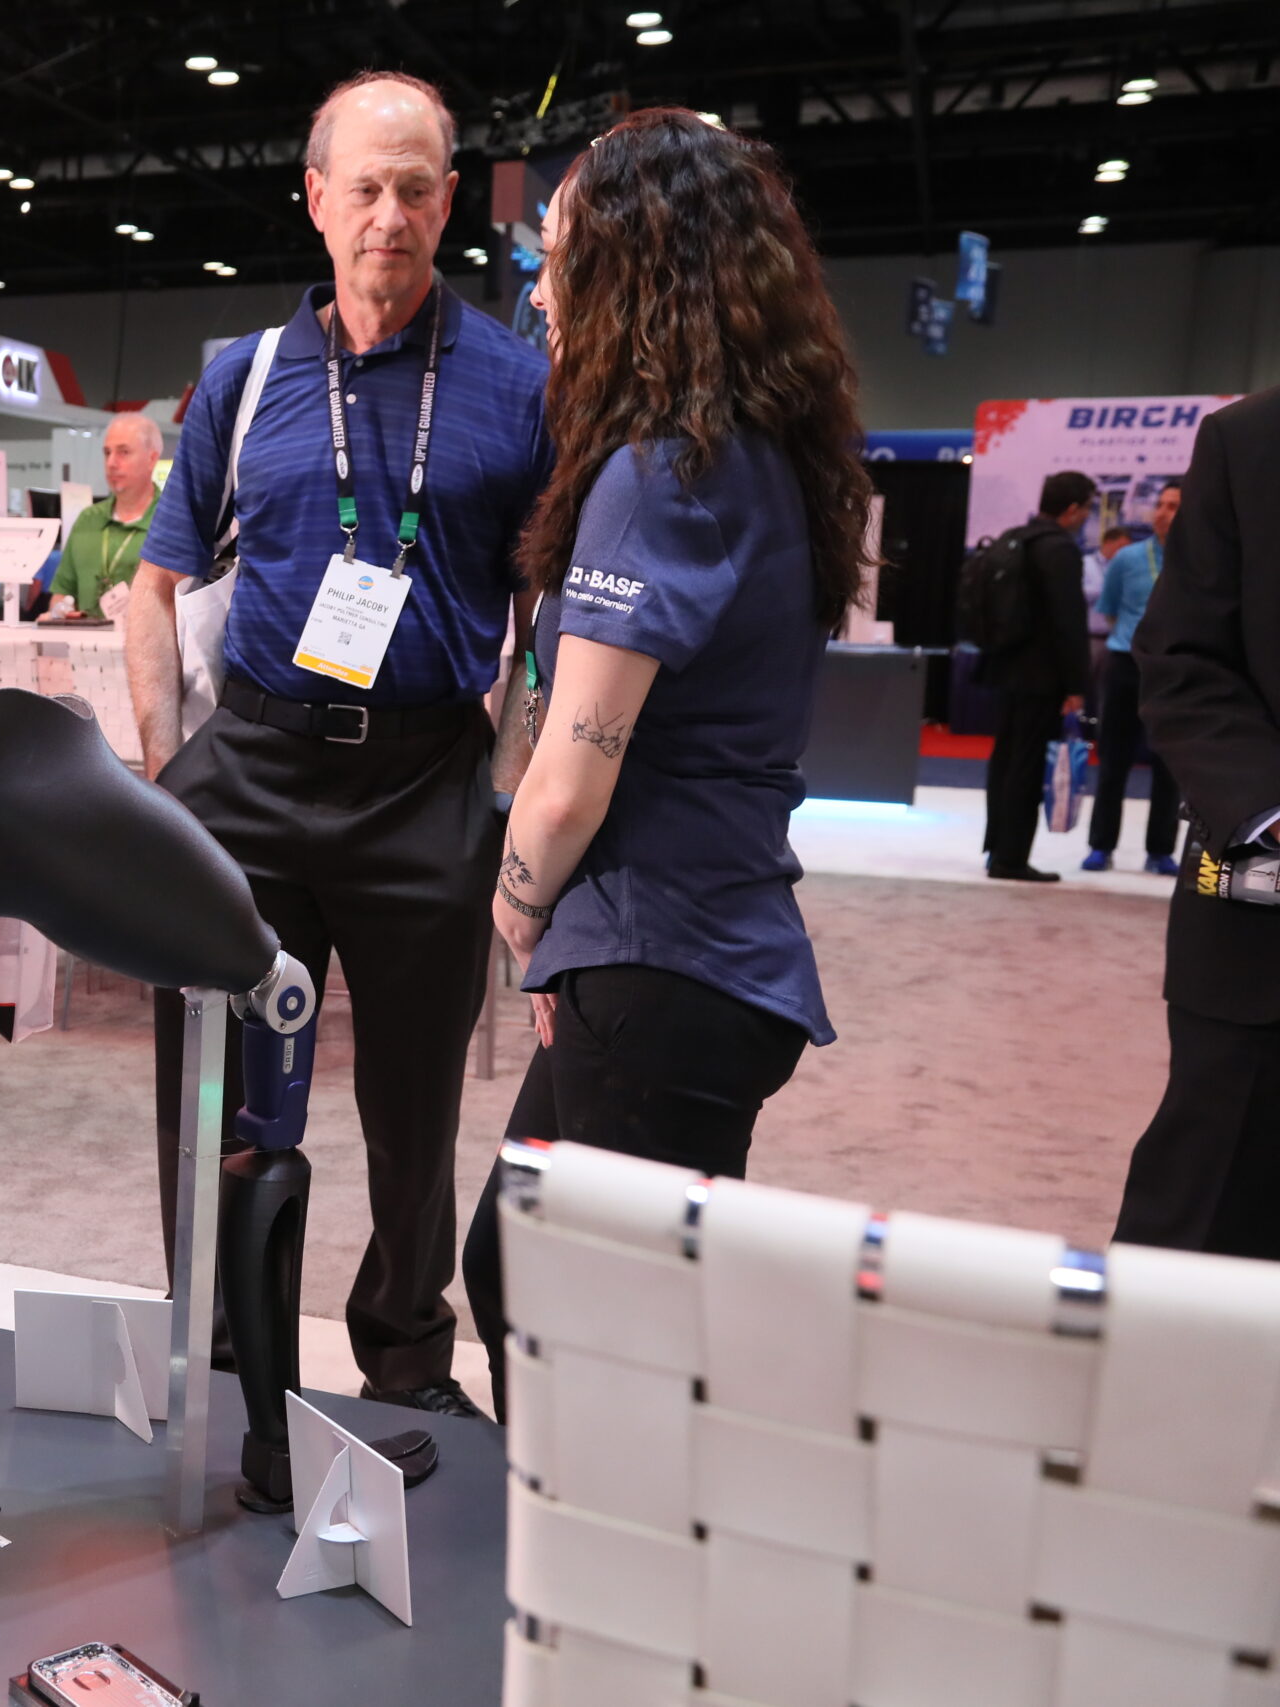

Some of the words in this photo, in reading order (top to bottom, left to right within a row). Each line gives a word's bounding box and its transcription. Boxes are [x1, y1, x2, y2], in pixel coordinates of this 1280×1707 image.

[328, 360, 339, 391] UPTIME
[419, 372, 435, 429] GUARANTEED
[329, 392, 345, 448] GUARANTEED
[1067, 405, 1201, 430] BIRCH
[414, 430, 429, 462] UPTIME
[589, 569, 644, 597] BASF
[327, 587, 355, 602] PHILIP
[356, 597, 389, 613] JACOBY
[566, 588, 577, 598] We
[594, 595, 634, 614] chemistry
[317, 662, 348, 677] Attendee
